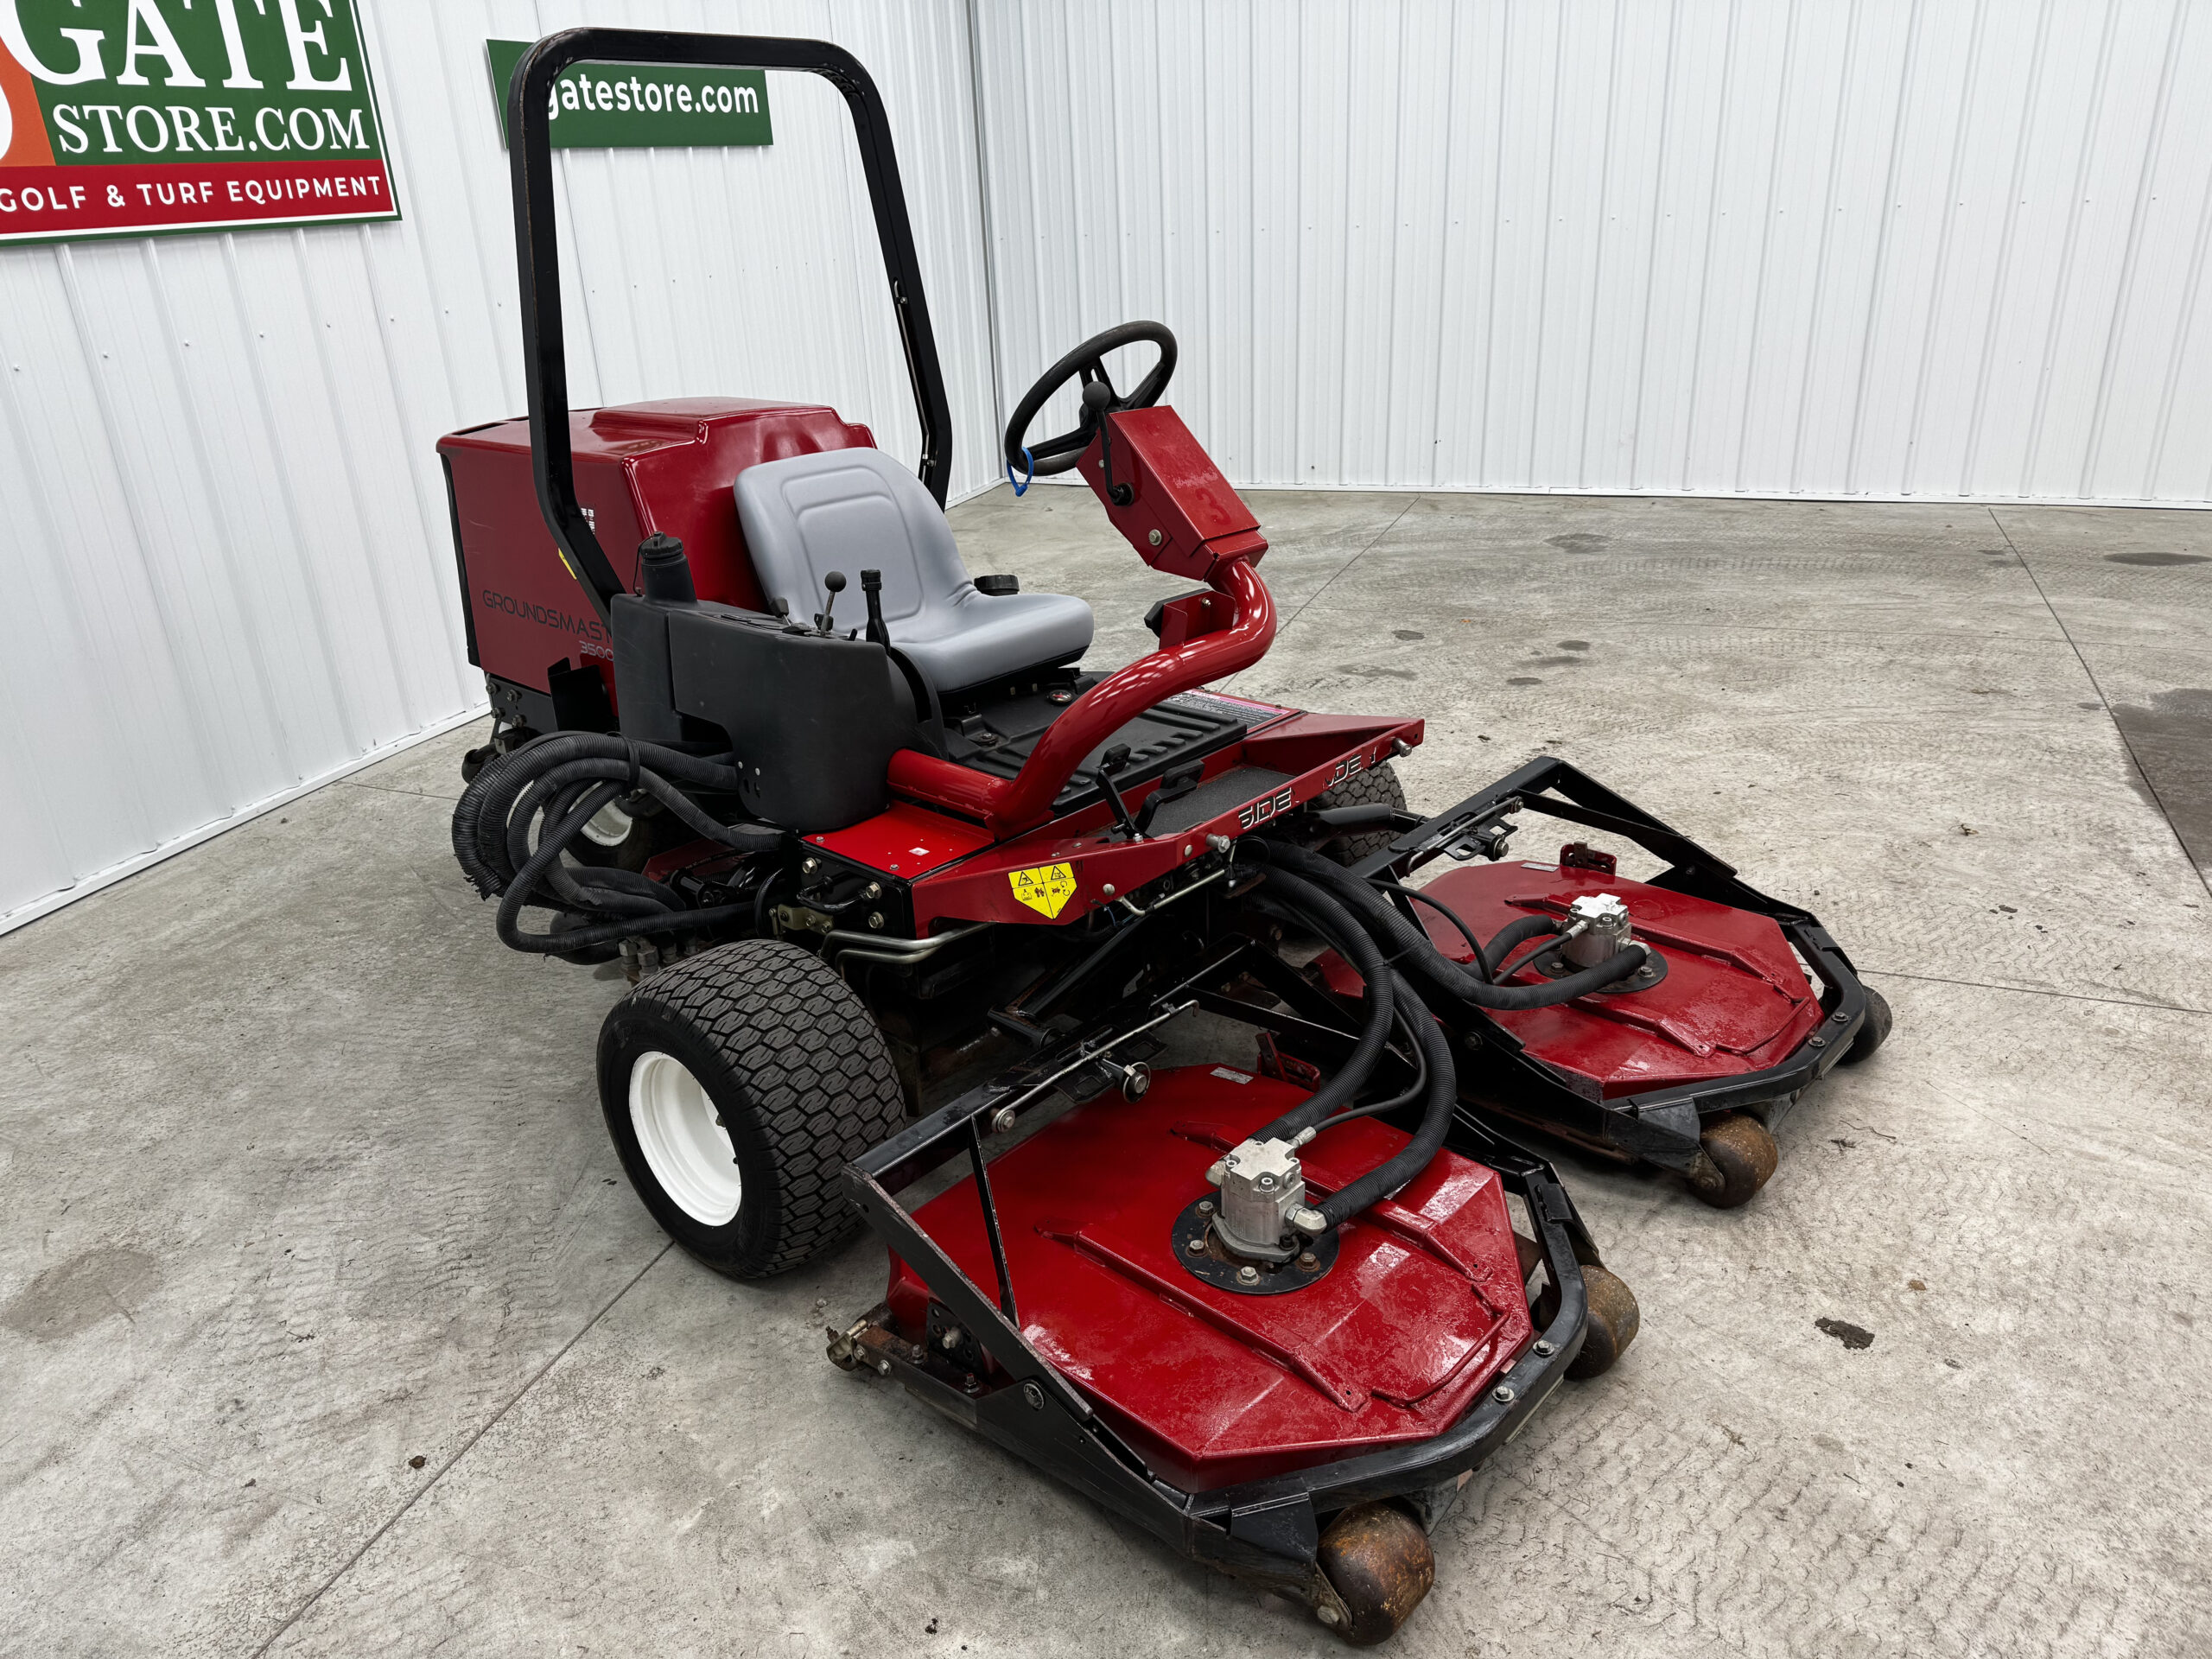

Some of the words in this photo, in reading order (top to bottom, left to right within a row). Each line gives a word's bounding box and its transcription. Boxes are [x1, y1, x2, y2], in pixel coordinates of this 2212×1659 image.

[0, 0, 352, 91] GATE
[53, 104, 371, 153] STORE.COM
[0, 186, 86, 213] GOLF
[107, 184, 126, 207] &
[137, 181, 214, 206] TURF
[226, 175, 380, 204] EQUIPMENT
[482, 589, 612, 645] GROUNDSMAST
[578, 639, 614, 662] 3500
